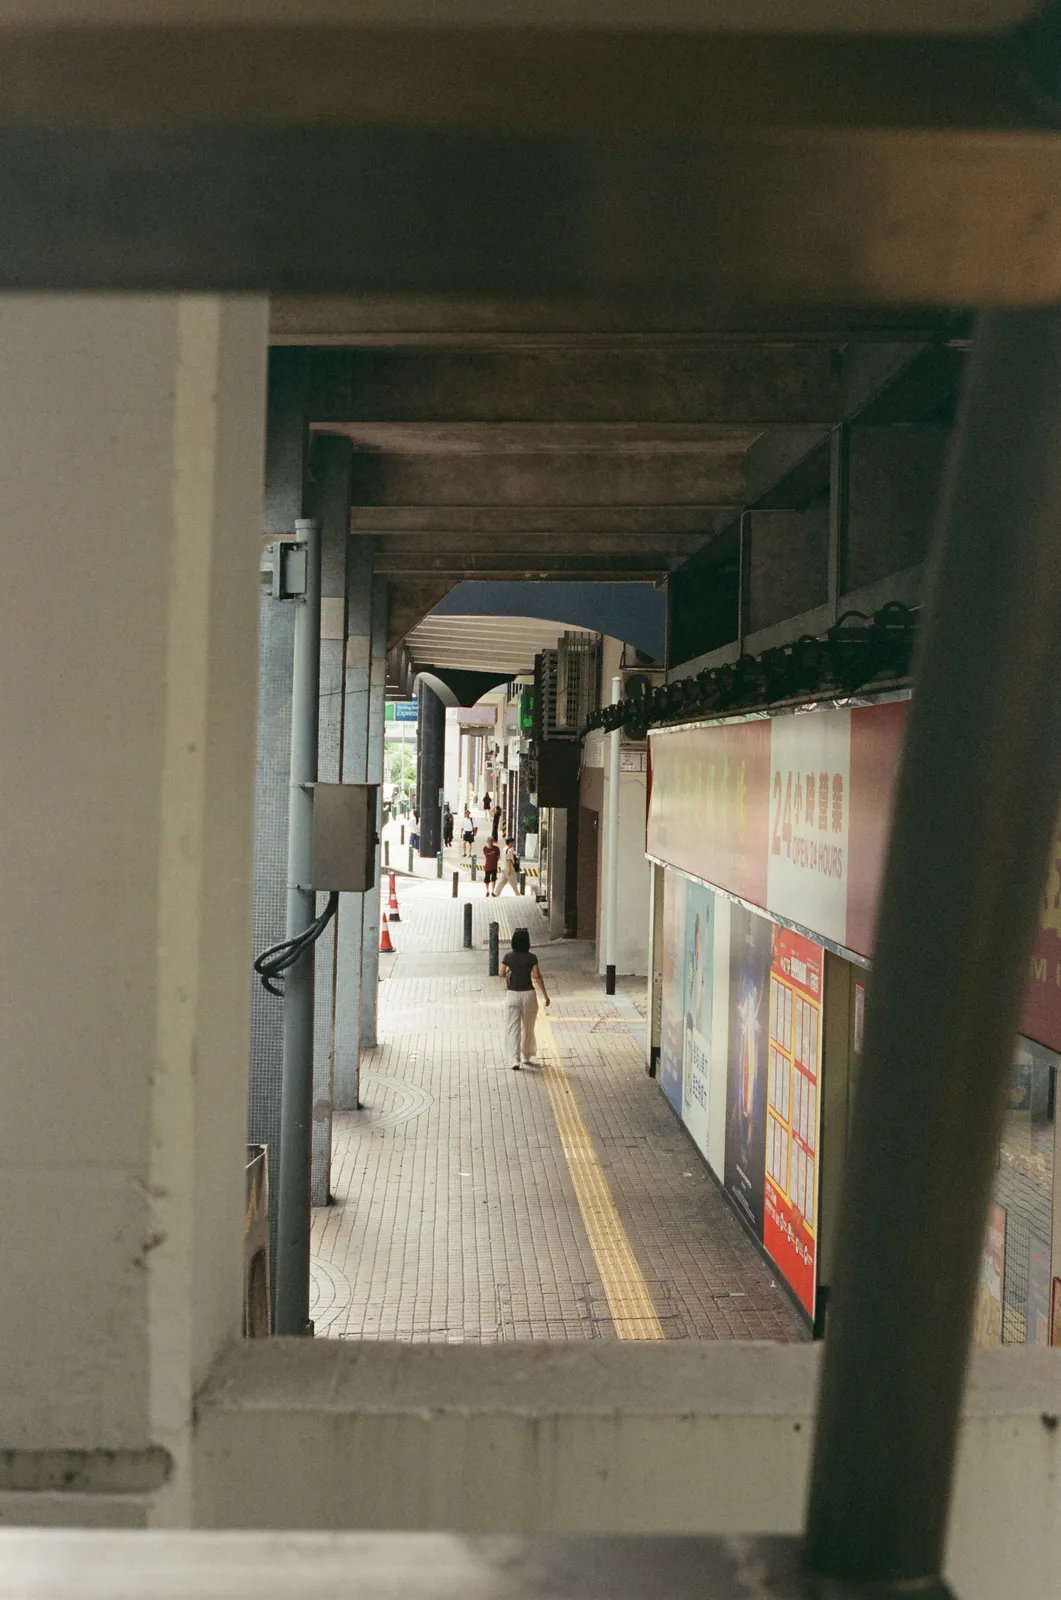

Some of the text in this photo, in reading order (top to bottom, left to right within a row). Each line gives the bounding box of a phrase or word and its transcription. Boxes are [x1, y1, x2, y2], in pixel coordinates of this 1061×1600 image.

[793, 836, 843, 879] OPEN 24 HOURS
